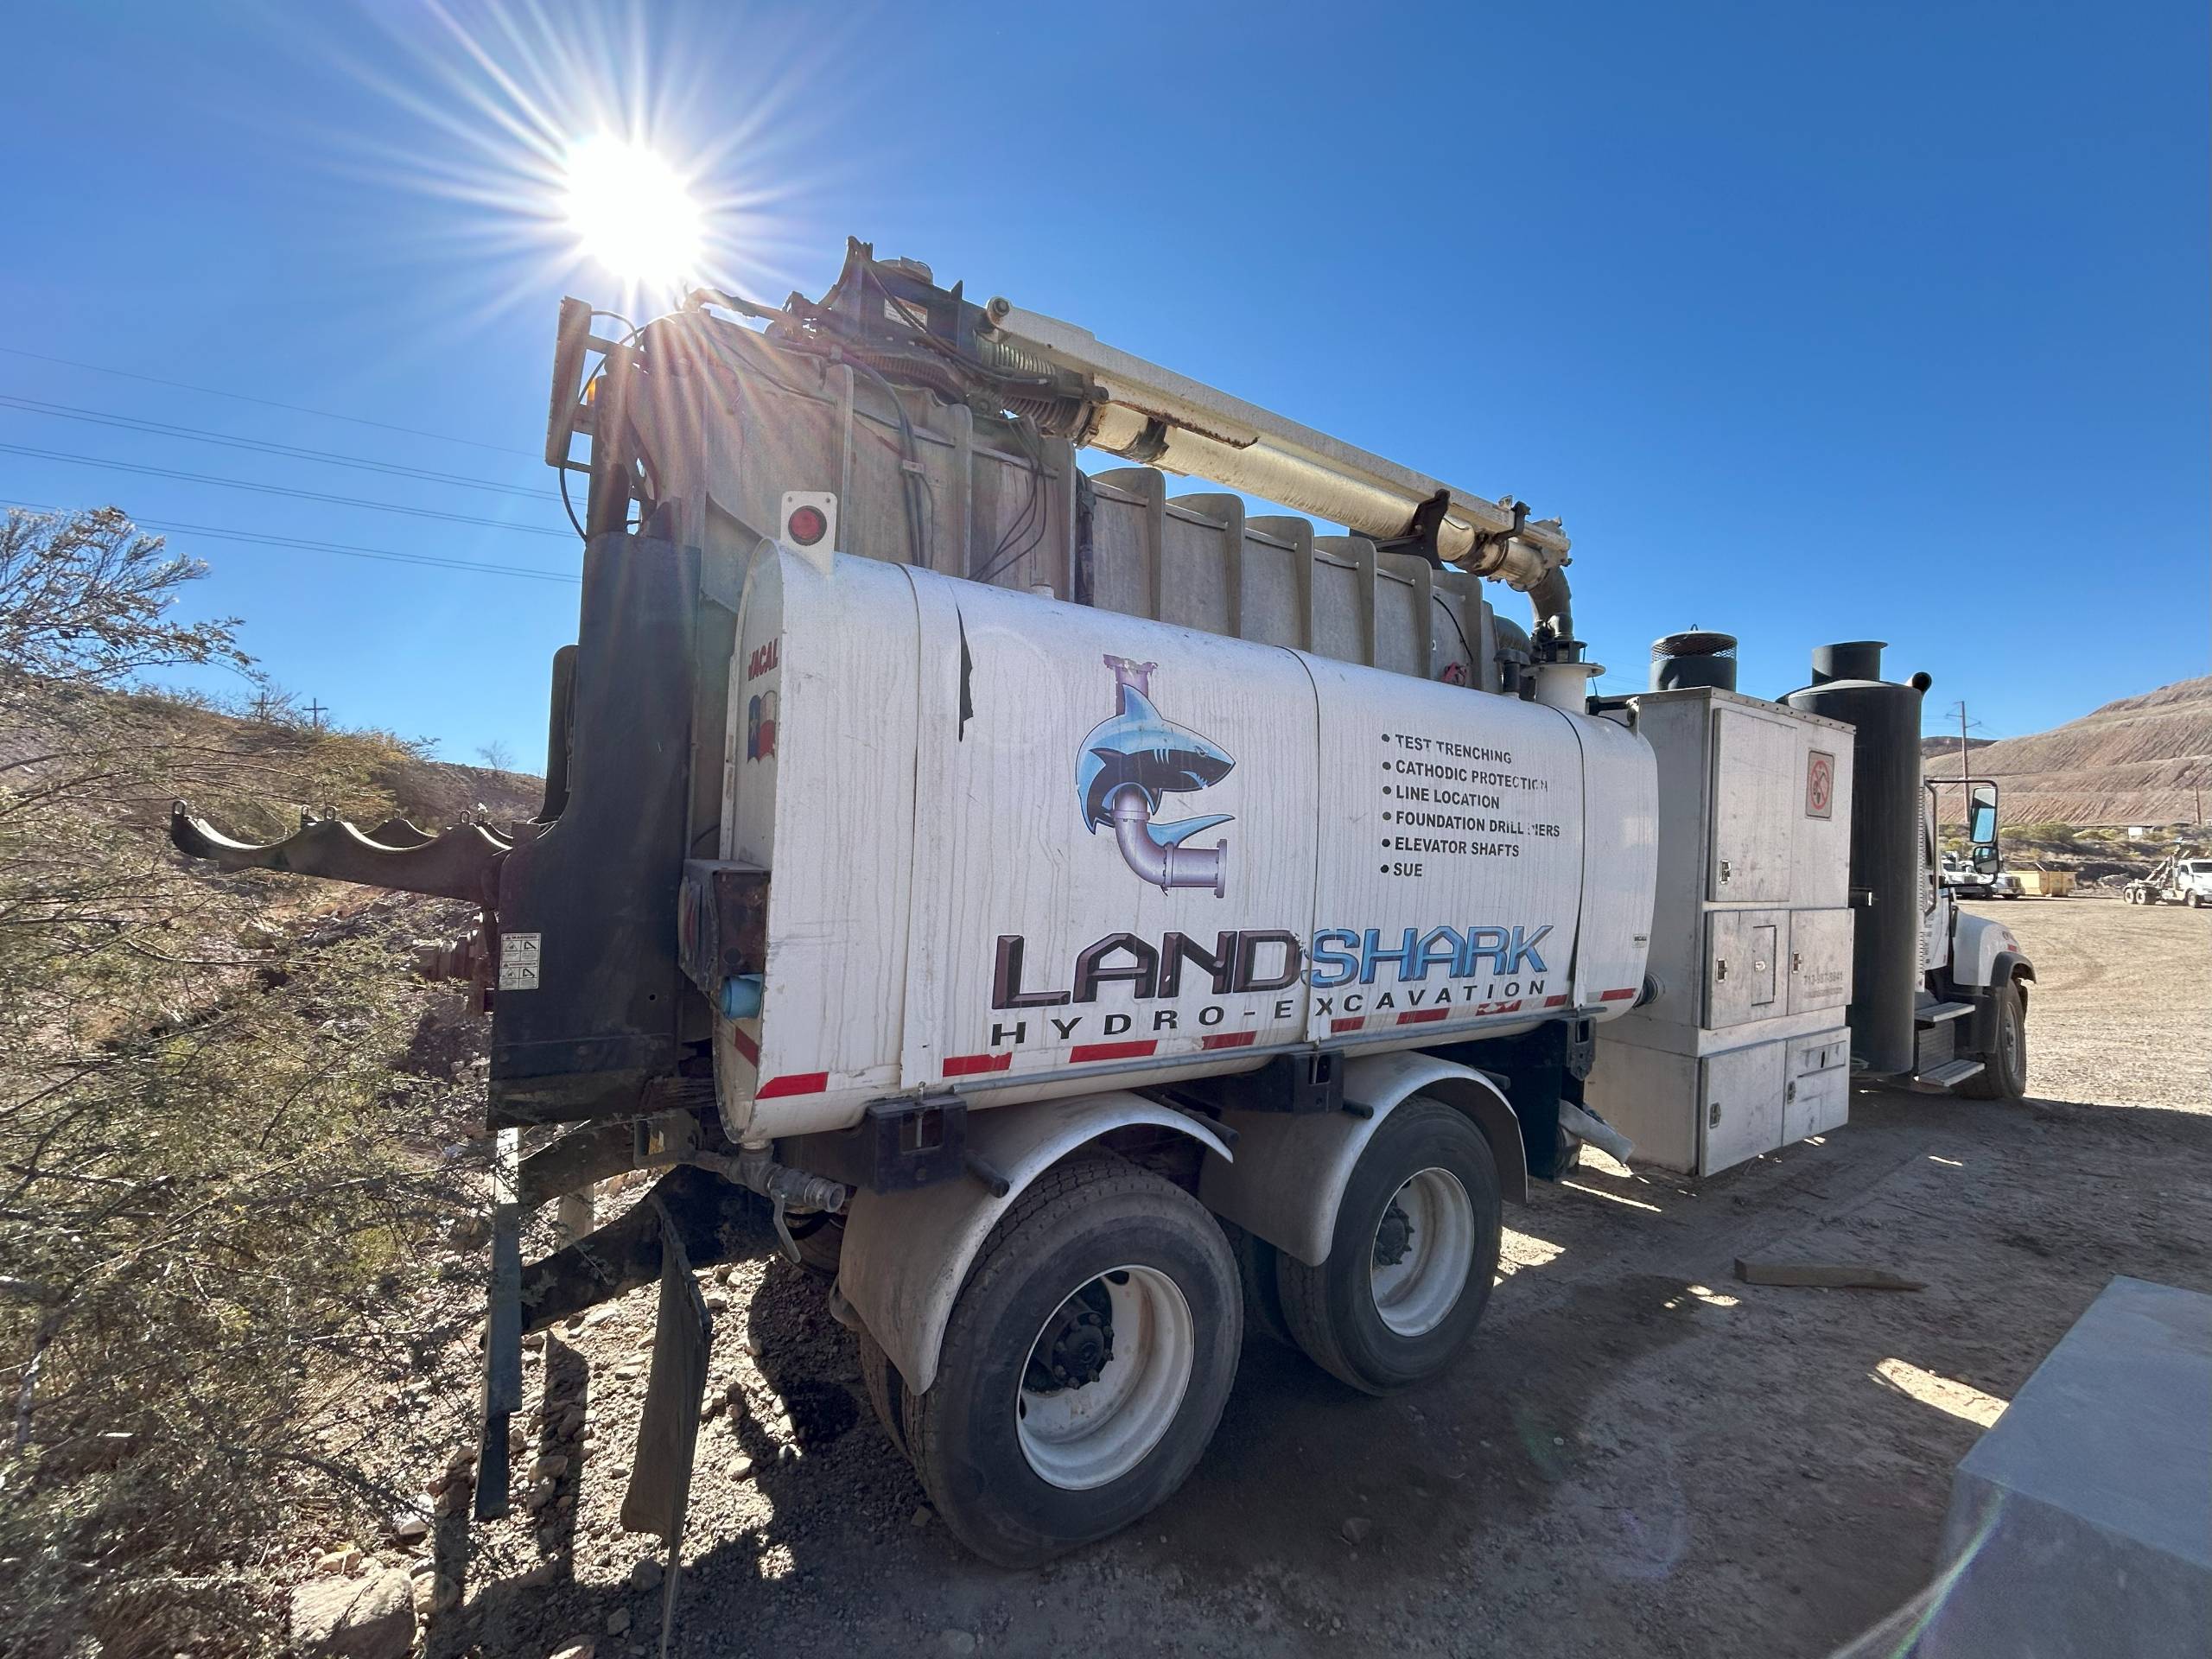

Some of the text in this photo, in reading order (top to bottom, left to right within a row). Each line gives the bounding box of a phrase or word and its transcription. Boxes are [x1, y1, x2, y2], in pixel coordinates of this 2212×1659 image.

[1395, 734, 1512, 764] TEST TRENCHING
[1395, 760, 1467, 782] CATHODIC
[1395, 785, 1500, 810] LINE LOCATION
[1395, 810, 1485, 831] FOUNDATION
[1489, 819, 1524, 836] DRILL
[1395, 836, 1520, 857] ELEVATOR SHAFTS
[1393, 862, 1423, 877] SUE
